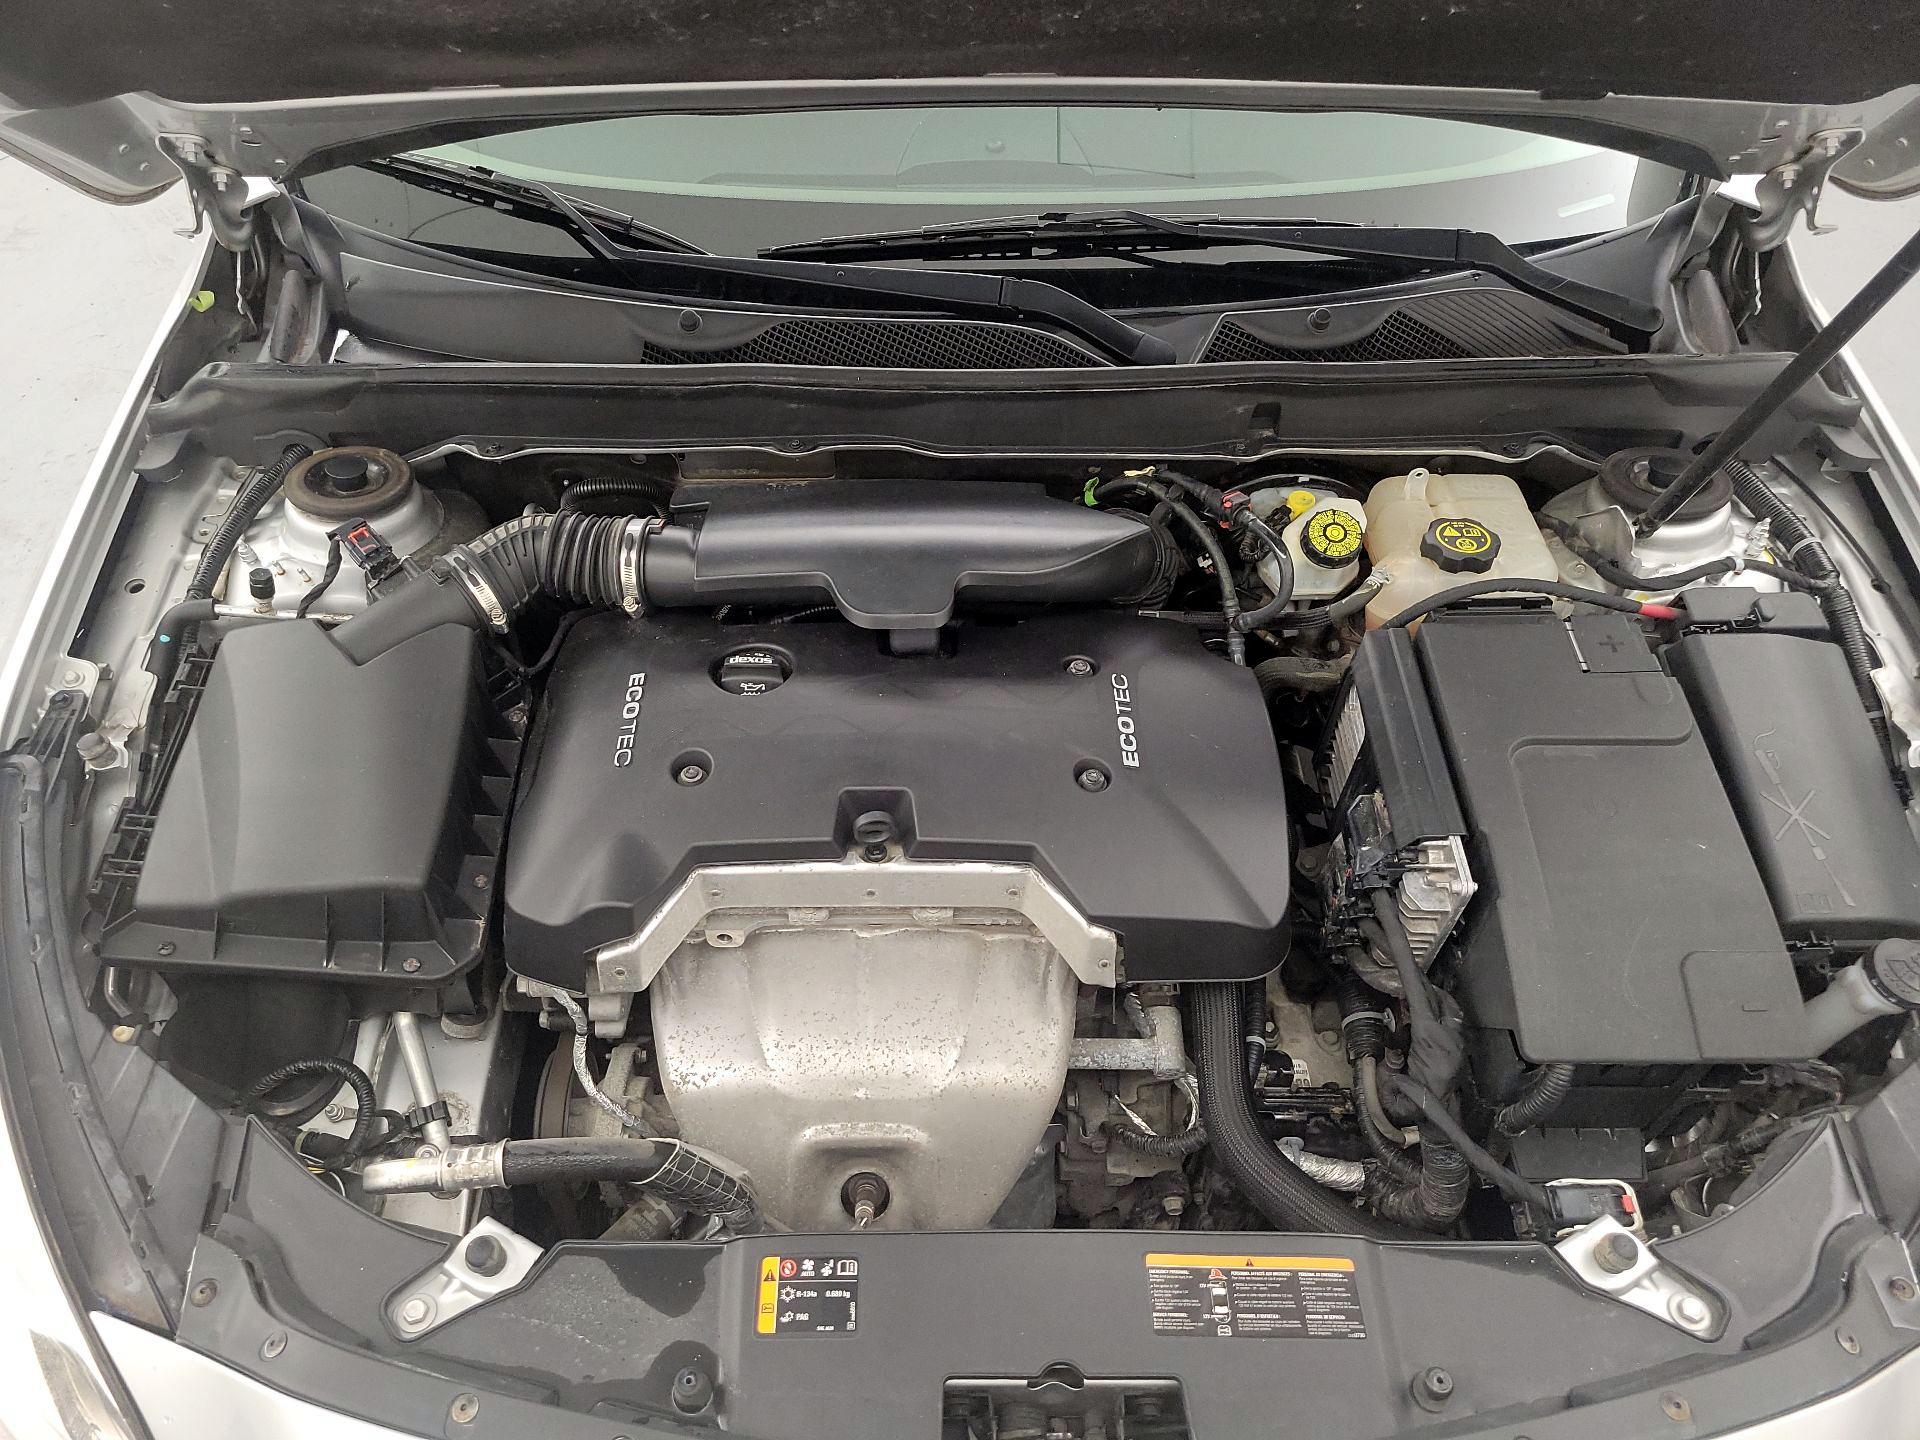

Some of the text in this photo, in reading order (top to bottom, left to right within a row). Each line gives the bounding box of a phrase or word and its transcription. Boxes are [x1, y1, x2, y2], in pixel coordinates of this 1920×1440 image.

[729, 655, 773, 664] dexos
[613, 672, 646, 767] ECOTEC
[1111, 673, 1140, 768] ECOTEC
[796, 1290, 818, 1298] R-134a
[842, 1290, 851, 1299] kg
[796, 1313, 809, 1321] PAG
